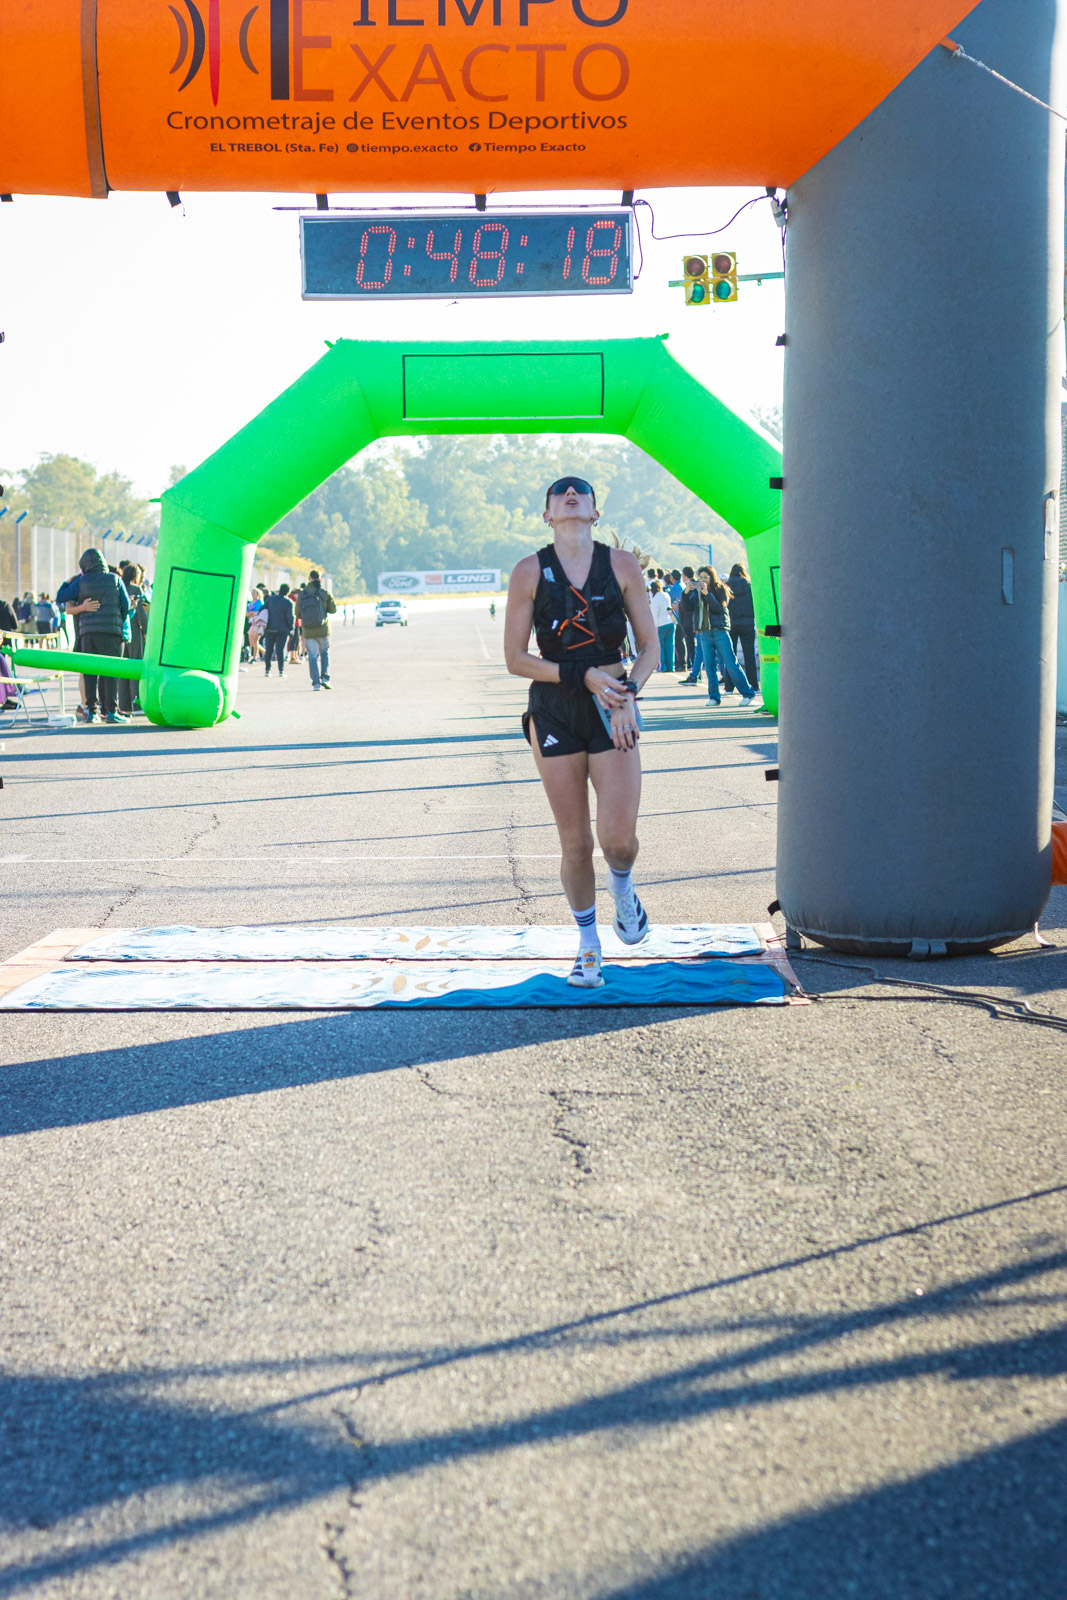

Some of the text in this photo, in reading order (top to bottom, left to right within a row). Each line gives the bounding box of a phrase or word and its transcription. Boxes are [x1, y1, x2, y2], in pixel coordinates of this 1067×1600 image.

[293, 0, 630, 102] EXACTO
[167, 111, 628, 134] Cronometraje de Eventos Deportivos
[210, 142, 458, 154] EL TREBOL (Sta. Fe) tiempo.exacto
[484, 142, 586, 154] Tiempo Exacto
[389, 576, 413, 587] Ford
[447, 575, 491, 583] LONG
